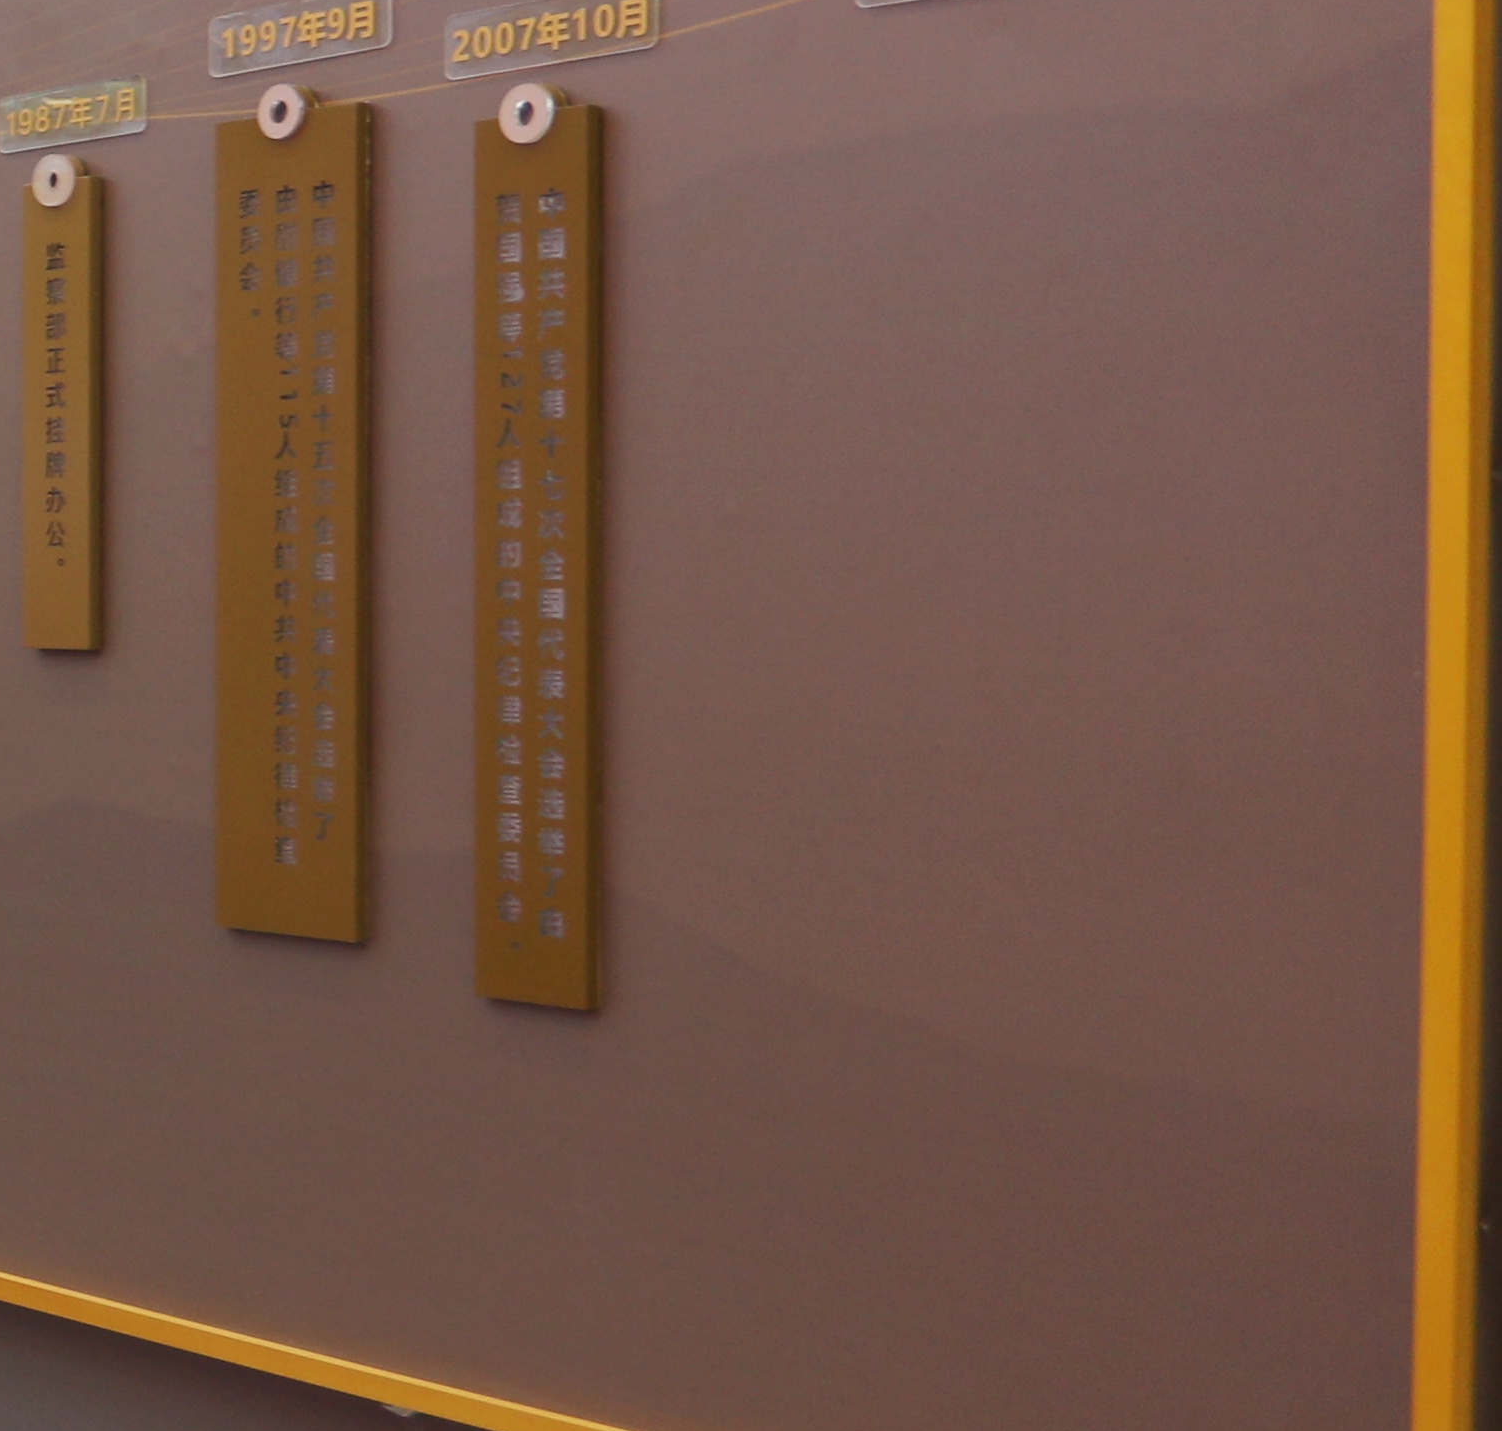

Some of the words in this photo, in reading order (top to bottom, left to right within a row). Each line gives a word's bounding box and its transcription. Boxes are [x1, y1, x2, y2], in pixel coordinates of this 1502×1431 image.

[221, 0, 376, 60] 1997年9月
[6, 87, 136, 137] 1987年7月
[45, 243, 67, 567] 监察部正式挂牌办公。
